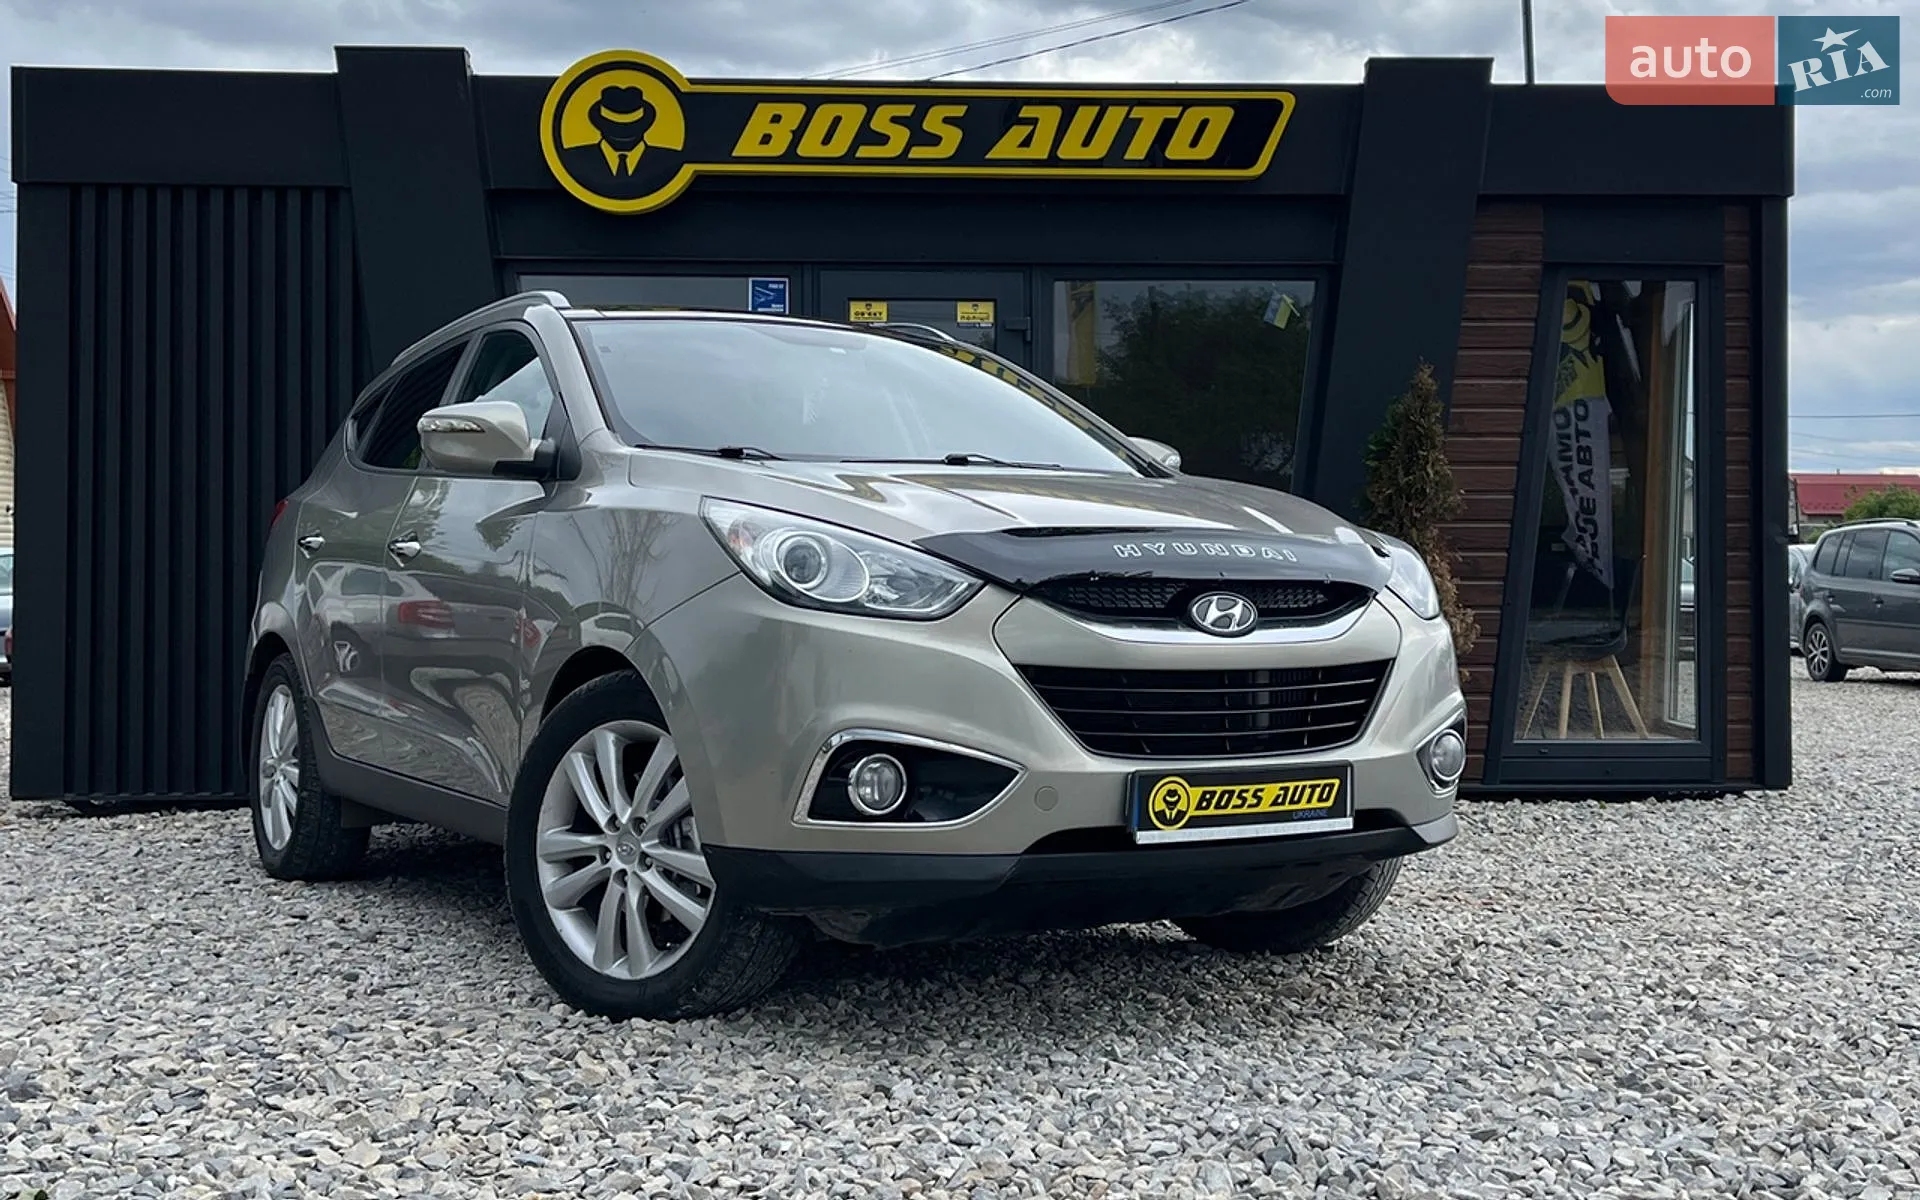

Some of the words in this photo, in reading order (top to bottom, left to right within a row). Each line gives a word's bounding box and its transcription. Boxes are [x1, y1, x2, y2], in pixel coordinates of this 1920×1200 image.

[731, 102, 969, 160] BOSS
[984, 104, 1235, 161] AUTO
[1573, 398, 1596, 491] АВТО
[1112, 542, 1298, 563] HYUNDAI
[1194, 787, 1265, 811] BOSS
[1269, 782, 1336, 808] AUTO
[1292, 808, 1329, 820] UKRAINE
